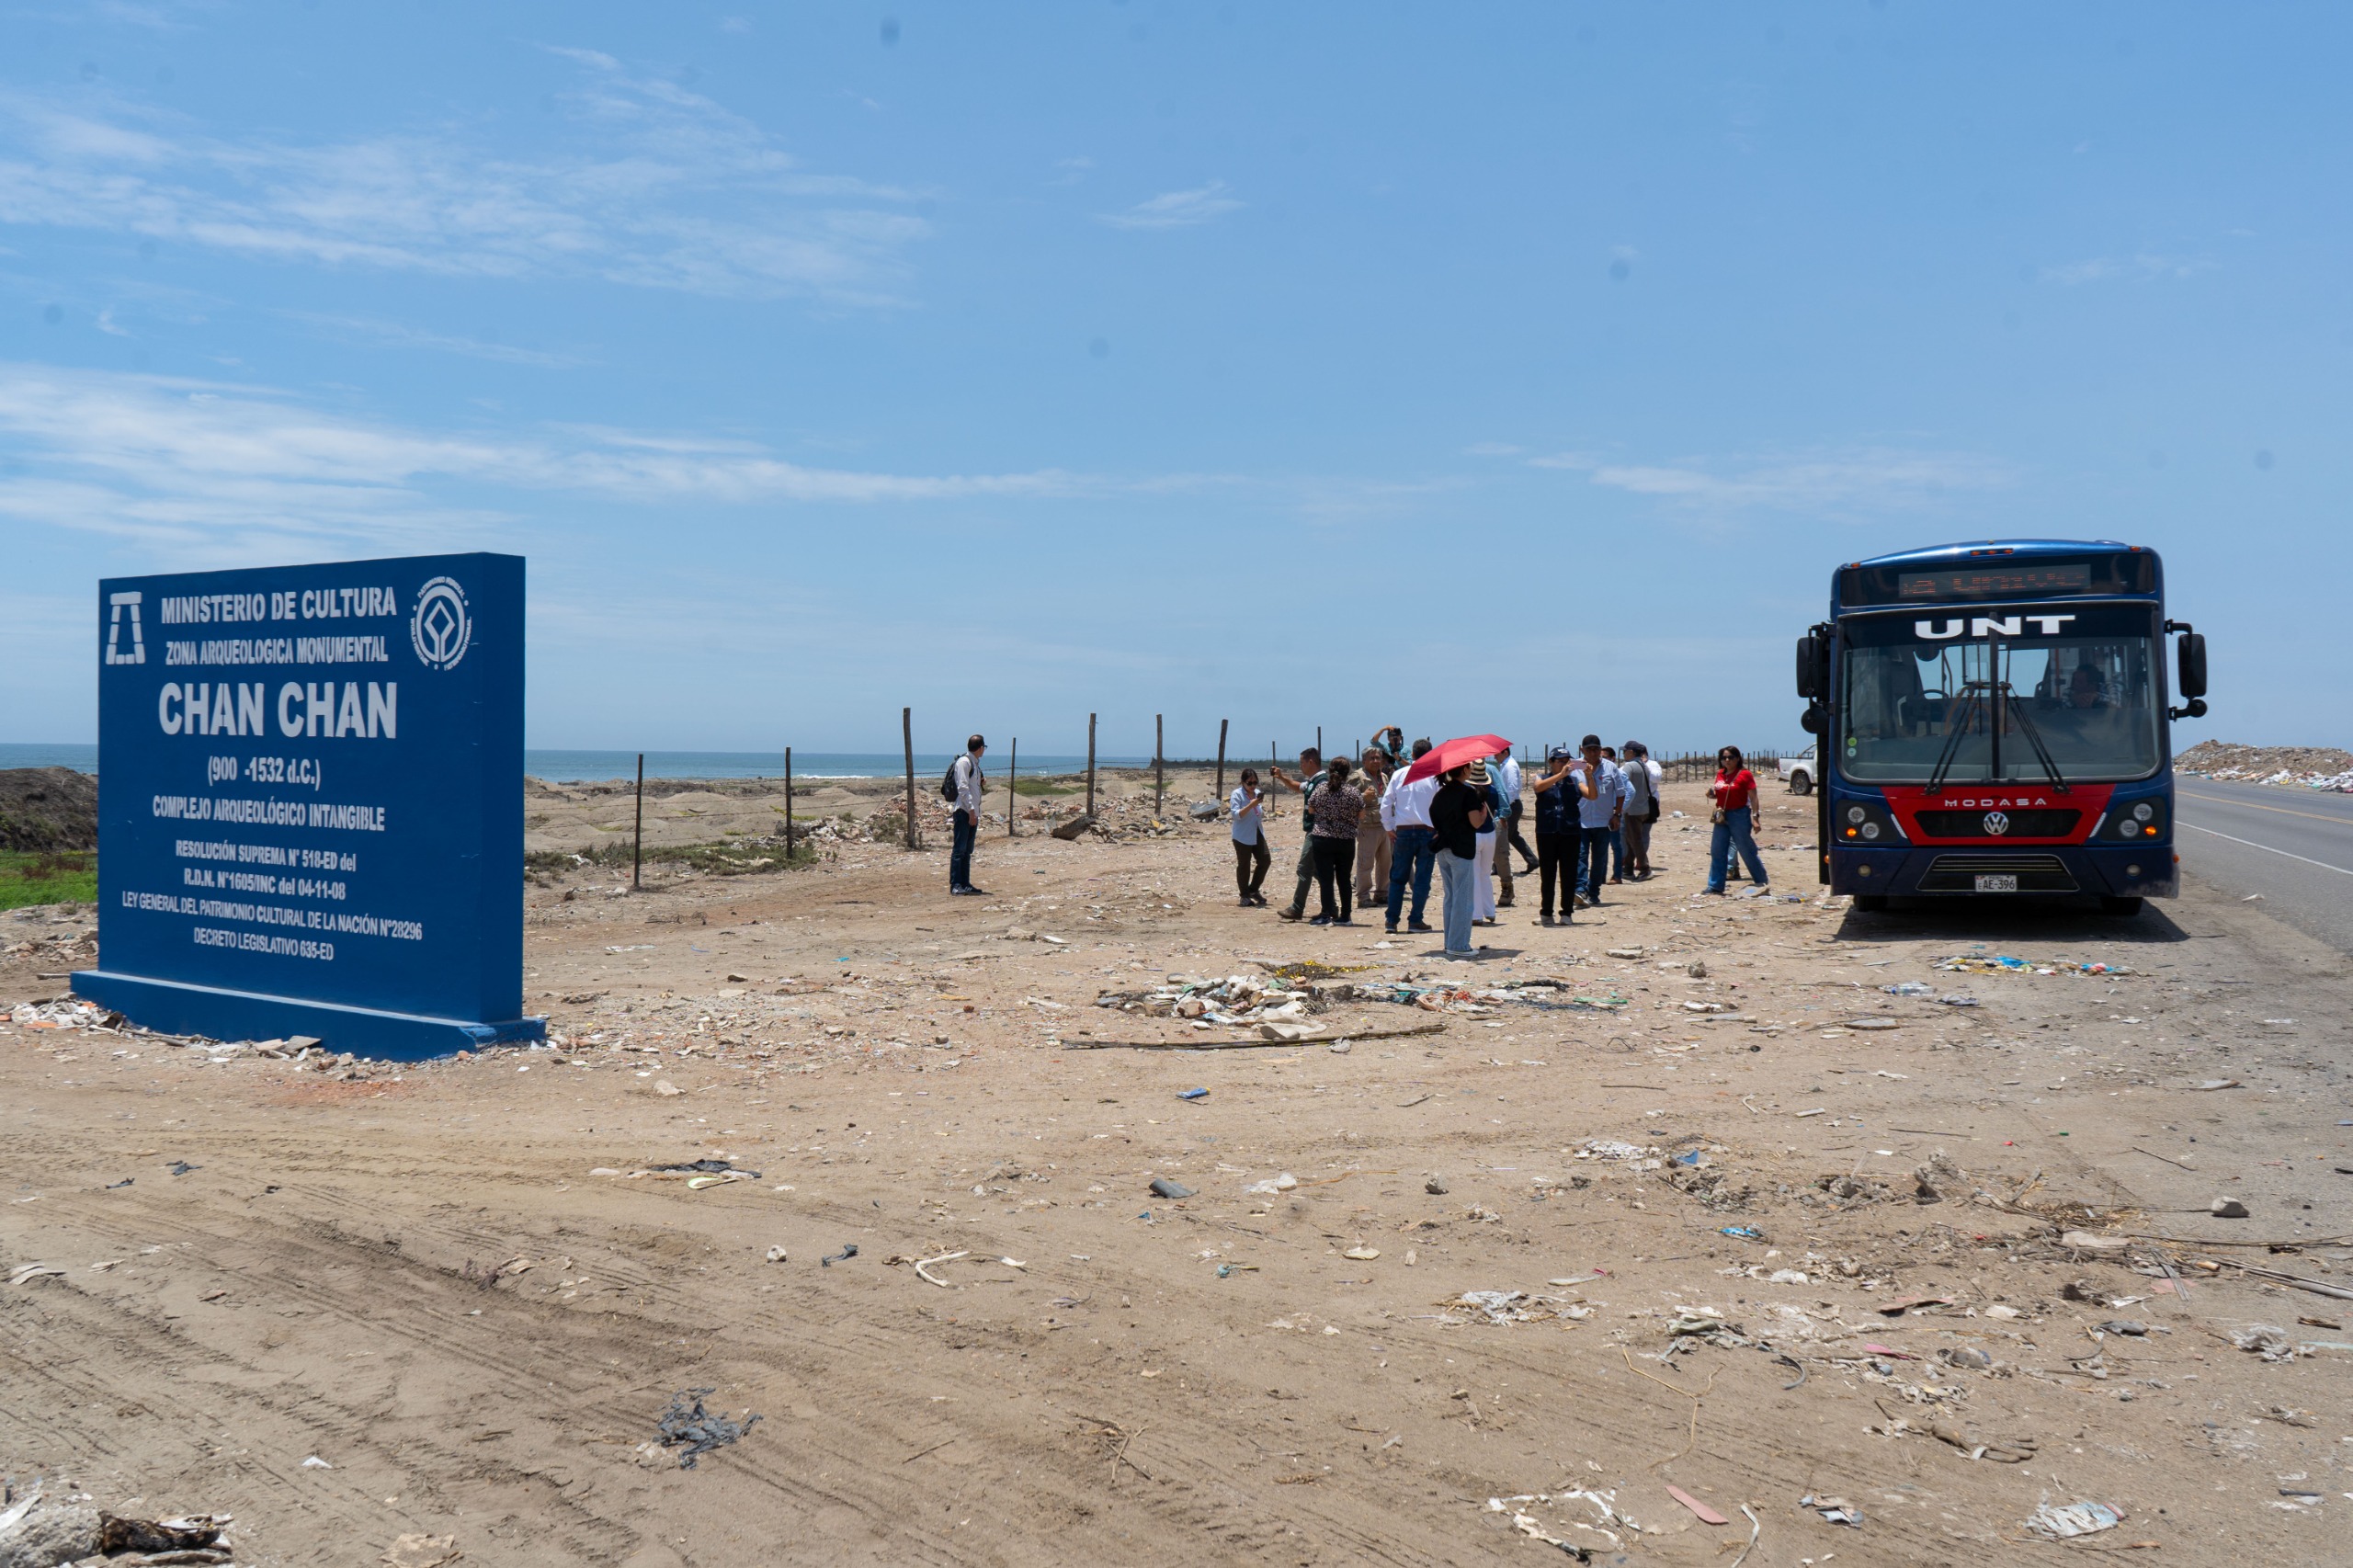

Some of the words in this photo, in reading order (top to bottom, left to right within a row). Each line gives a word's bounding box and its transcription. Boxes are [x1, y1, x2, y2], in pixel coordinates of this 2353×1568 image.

[161, 593, 266, 623] MINISTERIO
[271, 591, 297, 619] DE
[301, 586, 397, 619] CULTURA
[1915, 615, 2075, 639] UNT
[165, 641, 198, 665] ZONA
[199, 638, 294, 666] ARQUEOLOGICA
[297, 635, 389, 665] MONUMENTAL
[159, 683, 264, 735] CHAN
[278, 682, 397, 739] CHAN
[208, 756, 238, 786] (900
[244, 756, 285, 782] -1532
[287, 758, 321, 791] d.C.)
[153, 794, 211, 820] COMPLEJO
[213, 796, 306, 826] ARQUEOLÓGICO
[309, 803, 385, 832] INTANGIBLE
[1944, 798, 2047, 807] MODASA
[176, 839, 236, 861] RESOLUCIÓN
[238, 844, 287, 866] SUPREMA
[301, 849, 338, 870] 518-ED
[340, 852, 357, 872] del
[184, 868, 215, 887] R.D.N.
[278, 877, 296, 896] del
[298, 878, 347, 901] 04-11-08
[122, 891, 139, 908] LEY
[139, 892, 180, 913] GENERAL
[181, 897, 199, 915] DEL
[199, 900, 256, 922] PATRIMONIO
[256, 905, 306, 927] CULTURAL
[307, 911, 322, 929] DE
[323, 913, 336, 931] LA
[337, 913, 378, 936] NACIÓN
[194, 926, 236, 949] DECRETO
[238, 933, 299, 956] LEGISLATIVO
[300, 939, 334, 960] 635-ED
